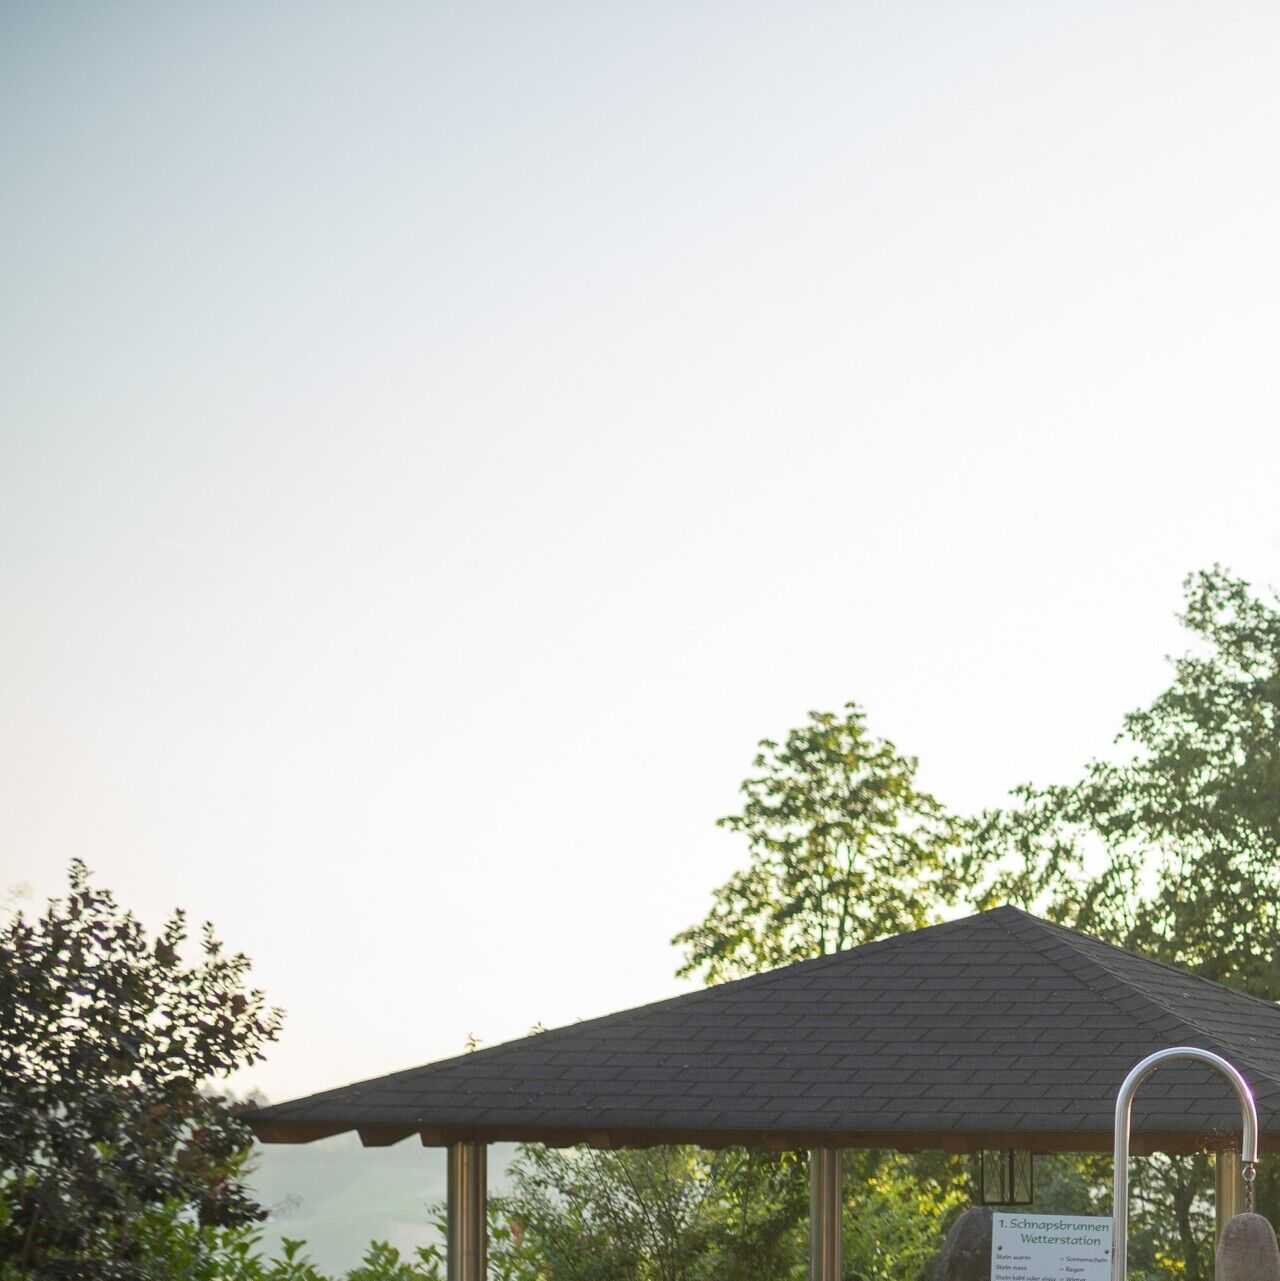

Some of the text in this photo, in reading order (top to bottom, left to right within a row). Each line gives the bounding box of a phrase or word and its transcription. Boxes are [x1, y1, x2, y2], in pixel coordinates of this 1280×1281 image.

[998, 1218, 1110, 1233] 1. Schnapsbrunnen
[1021, 1233, 1101, 1246] Wetterstation
